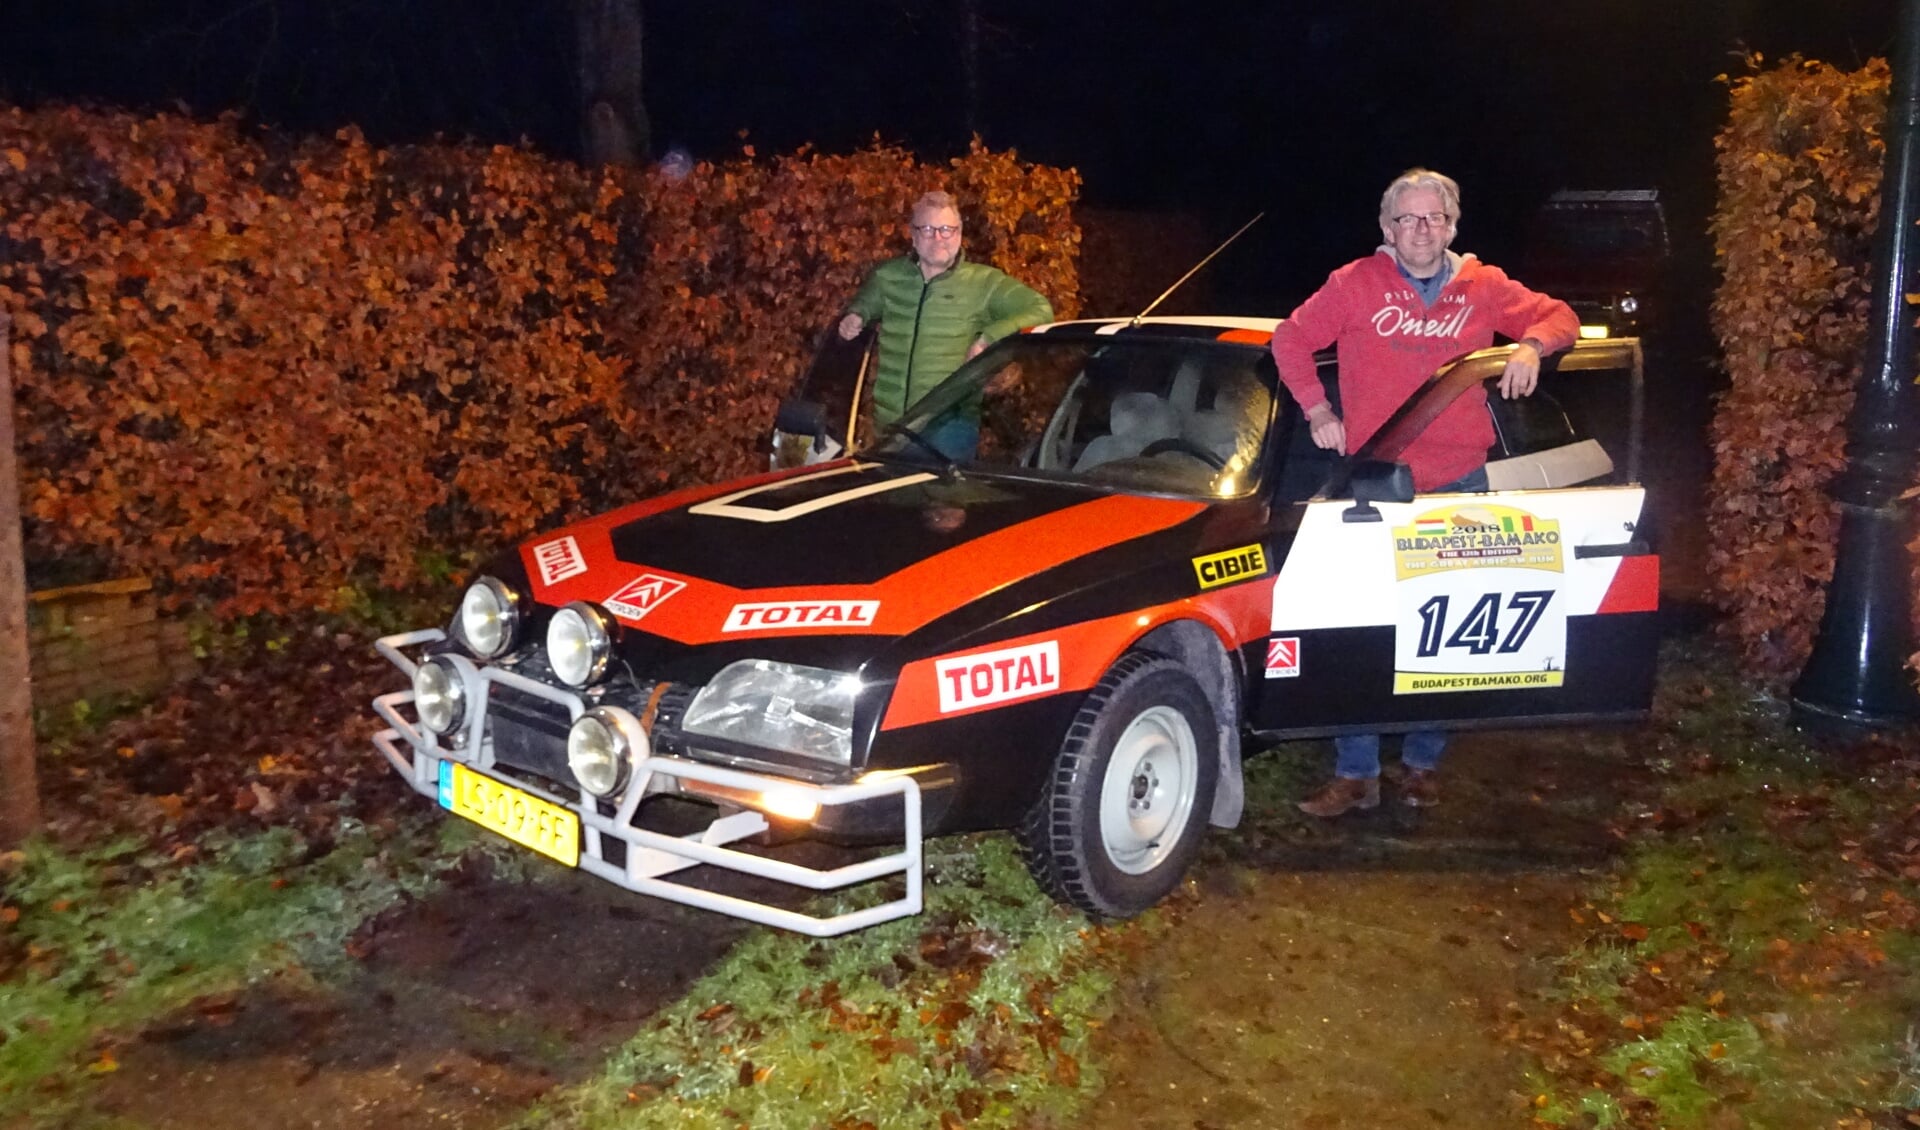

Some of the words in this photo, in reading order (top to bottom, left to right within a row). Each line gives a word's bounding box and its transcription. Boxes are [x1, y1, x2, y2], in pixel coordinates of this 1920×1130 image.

[1451, 524, 1501, 535] 2018
[1397, 531, 1559, 551] BUDAPEST-BAMAKO
[539, 539, 578, 581] TOTAL
[738, 605, 868, 627] TOTAL
[1416, 590, 1556, 658] 147
[945, 653, 1055, 702] TOTAL
[1412, 674, 1548, 689] BUDAPESTBAMAKO.ORG
